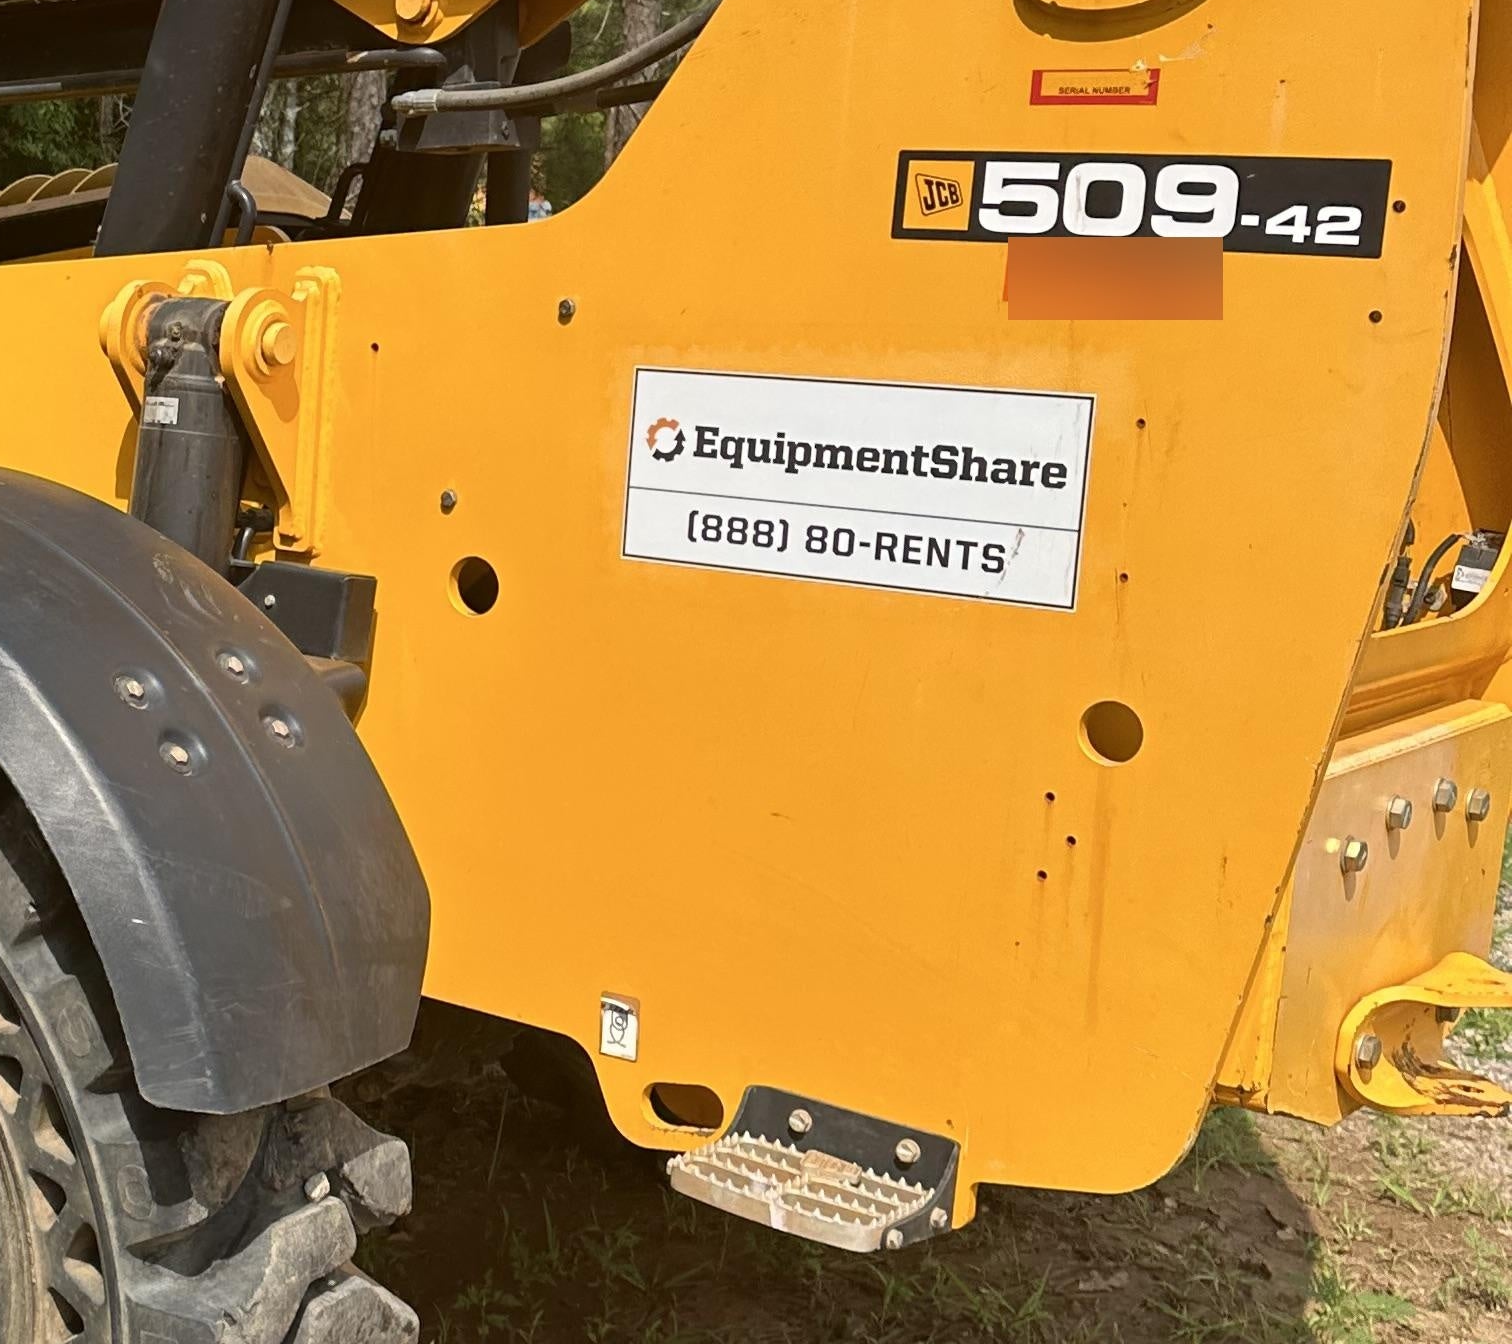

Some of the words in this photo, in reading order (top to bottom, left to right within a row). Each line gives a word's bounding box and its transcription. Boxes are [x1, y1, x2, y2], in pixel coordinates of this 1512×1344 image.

[1058, 86, 1090, 95] SERIAL
[1092, 86, 1131, 95] NUMBER
[922, 178, 960, 212] JCB
[976, 160, 1364, 248] 509-42
[692, 424, 1069, 490] EquipmentShare
[687, 509, 790, 553] (888)
[805, 524, 1006, 575] 80-RENTS
